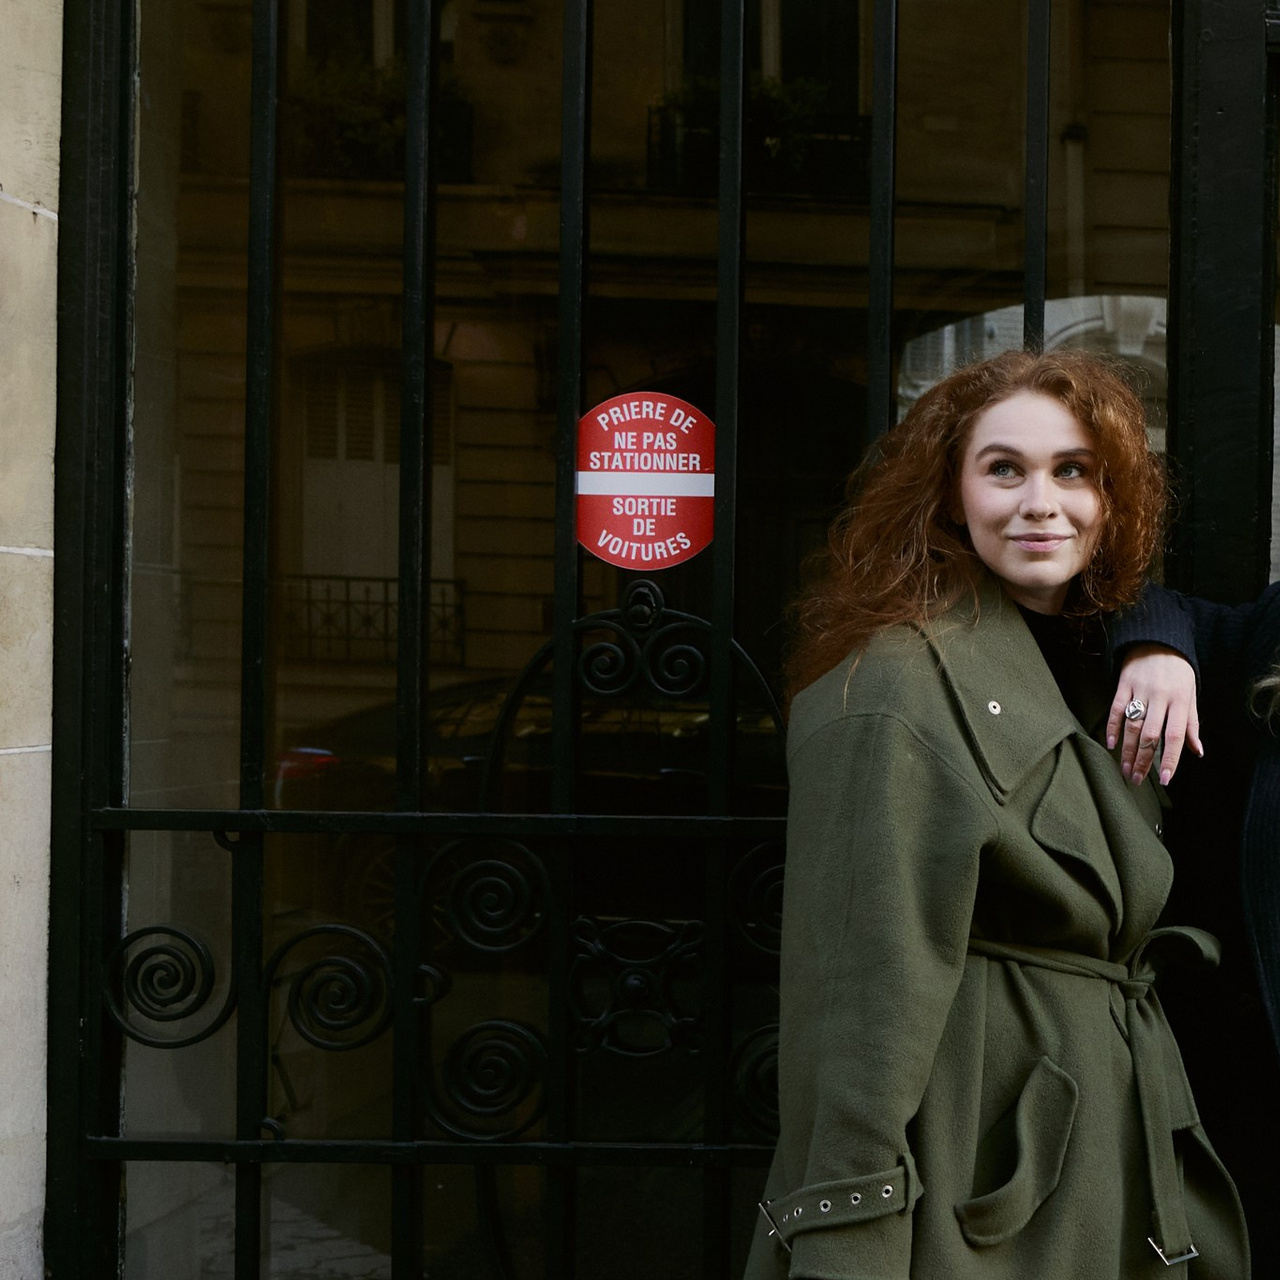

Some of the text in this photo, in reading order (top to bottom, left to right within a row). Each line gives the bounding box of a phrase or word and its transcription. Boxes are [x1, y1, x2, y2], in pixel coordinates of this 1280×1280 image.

[597, 400, 698, 434] PRIERE DE
[614, 431, 677, 451] NE PAS
[589, 451, 701, 471] STATIONNER
[612, 497, 676, 516] SORTIE
[632, 518, 656, 536] DE
[597, 529, 692, 562] VOITURES
